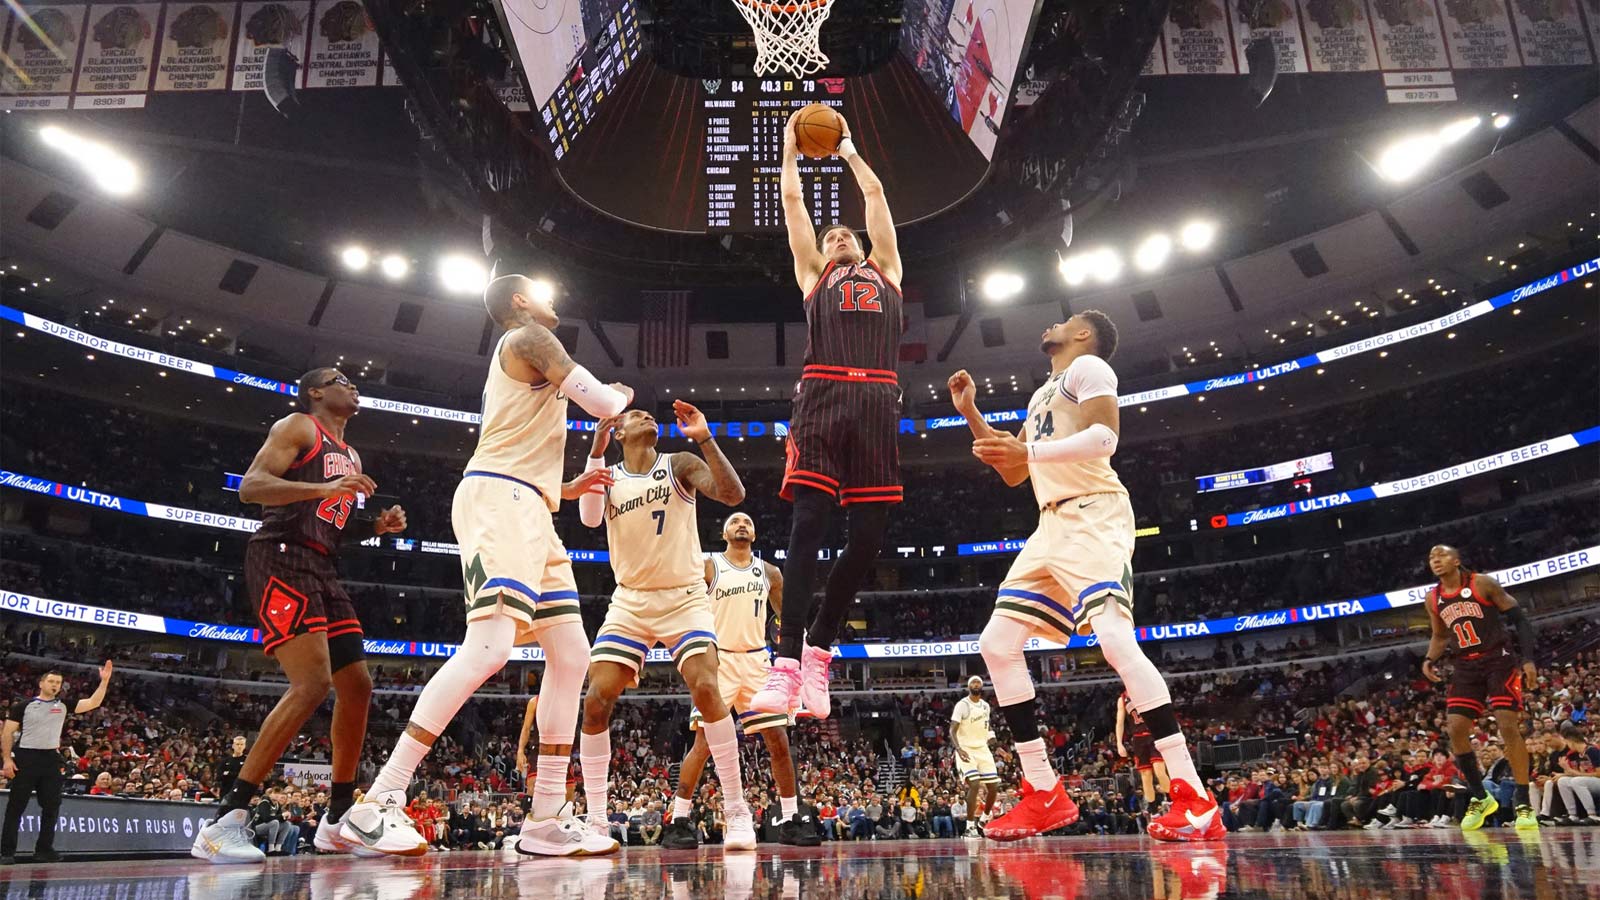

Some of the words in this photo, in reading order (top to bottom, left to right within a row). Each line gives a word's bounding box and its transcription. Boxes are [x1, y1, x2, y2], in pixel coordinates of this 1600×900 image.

[178, 47, 214, 56] CHICAGO
[315, 51, 371, 60] BLACKHAWKS
[326, 42, 362, 51] CHICAGO
[166, 55, 222, 64] BLACKHAWKS
[310, 61, 341, 70] CENTRAL
[343, 60, 378, 69] DIVISION
[168, 72, 215, 81] CHAMPIONS
[318, 69, 366, 78] CHAMPIONS
[731, 80, 744, 93] 84
[760, 80, 781, 93] 40.3
[802, 80, 815, 92] 79
[704, 100, 736, 108] MILWAUKEE
[706, 166, 730, 174] CHICAGO
[715, 210, 730, 218] SMITH
[715, 219, 730, 227] JONES
[1511, 275, 1559, 303] Michelob
[1572, 257, 1600, 279] ULT
[839, 280, 883, 314] 12
[1333, 333, 1395, 359] SUPERIOR
[1397, 320, 1436, 342] LIGHT
[1439, 308, 1472, 329] BEER
[41, 319, 110, 352] SUPERIOR
[112, 342, 154, 362] LIGHT
[157, 353, 194, 371] BEER
[233, 371, 278, 392] Michelob
[1204, 374, 1246, 392] Michelob
[1256, 360, 1301, 380] ULTRA
[1140, 389, 1169, 403] BEER
[371, 398, 431, 418] SUPERIOR
[432, 406, 468, 423] LIGHT
[1034, 410, 1055, 442] 34
[1391, 468, 1461, 494] SUPERIOR
[1465, 453, 1506, 476] LIGHT
[1510, 442, 1550, 463] BEER
[0, 470, 52, 495] Michelob
[66, 485, 123, 510] ULTRA
[316, 493, 357, 531] 25
[608, 496, 646, 521] Cream
[646, 484, 673, 506] City
[1242, 505, 1288, 526] Michelob
[1300, 492, 1352, 513] ULTRA
[165, 506, 238, 529] SUPERIOR
[241, 520, 264, 534] LIG
[651, 509, 667, 538] 7
[566, 550, 595, 560] CLUB
[774, 549, 787, 560] 40.
[972, 543, 998, 553] ULTRA
[1004, 541, 1025, 552] CLU
[1495, 563, 1543, 587] LIGHT
[1547, 551, 1590, 574] BEER
[715, 586, 746, 601] Cream
[746, 581, 764, 597] City
[34, 598, 89, 620] LIGHT
[94, 608, 138, 627] BEER
[1234, 608, 1288, 633] Michelob
[1301, 600, 1365, 622] ULTRA
[1440, 601, 1484, 629] CHICAGO
[189, 621, 249, 643] Michelob
[1151, 622, 1211, 641] ULTRA
[1453, 619, 1482, 650] 11
[422, 643, 458, 658] ULT
[646, 649, 670, 662] BEE
[883, 643, 954, 657] SUPERIOR
[957, 642, 979, 656] LIG
[297, 769, 332, 781] Advocat
[124, 816, 140, 833] AT
[145, 818, 177, 835] RUSH
